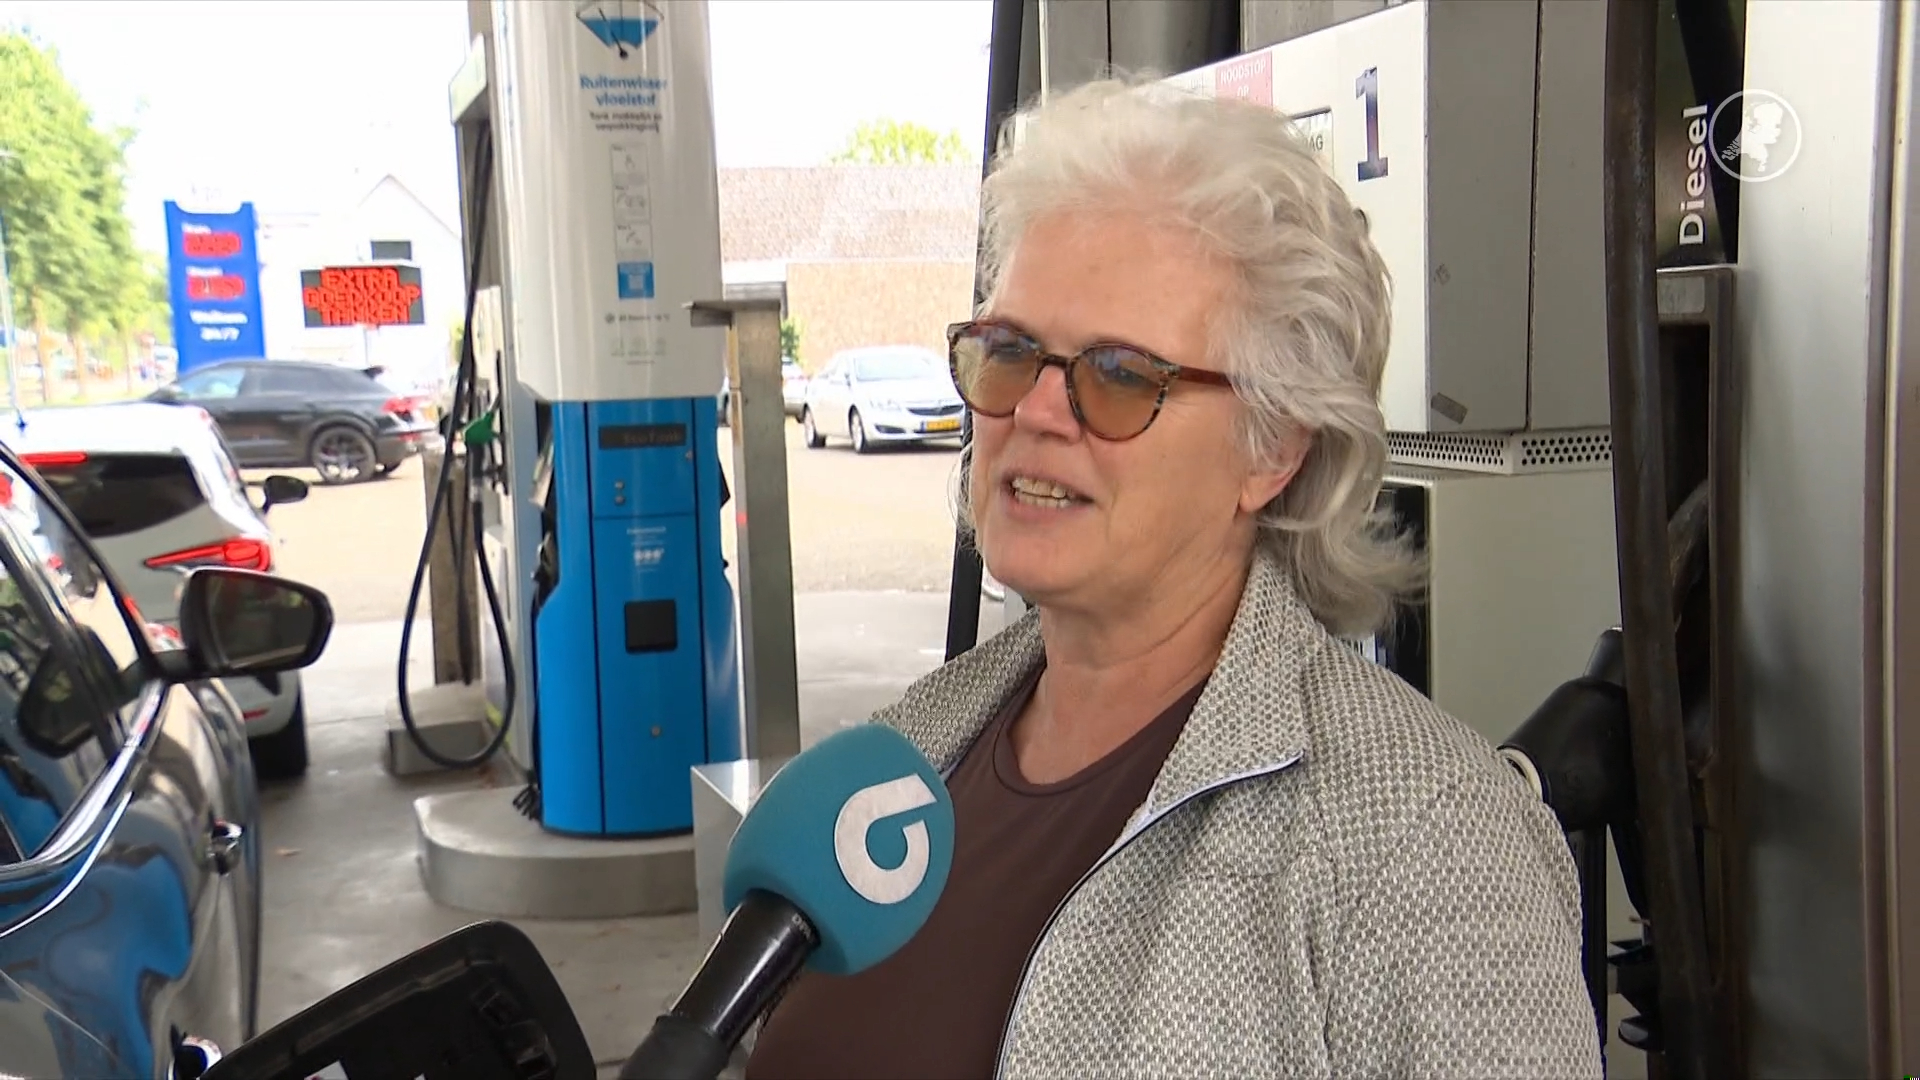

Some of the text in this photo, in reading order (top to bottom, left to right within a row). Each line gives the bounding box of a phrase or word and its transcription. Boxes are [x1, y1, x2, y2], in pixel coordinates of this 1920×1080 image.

[1220, 58, 1266, 85] NOODSTOP
[1355, 65, 1389, 182] 1
[1679, 104, 1708, 246] Diesel
[321, 267, 399, 290] EXTRA
[303, 285, 421, 309] GOEDKOOP
[321, 303, 410, 326] TANKEN
